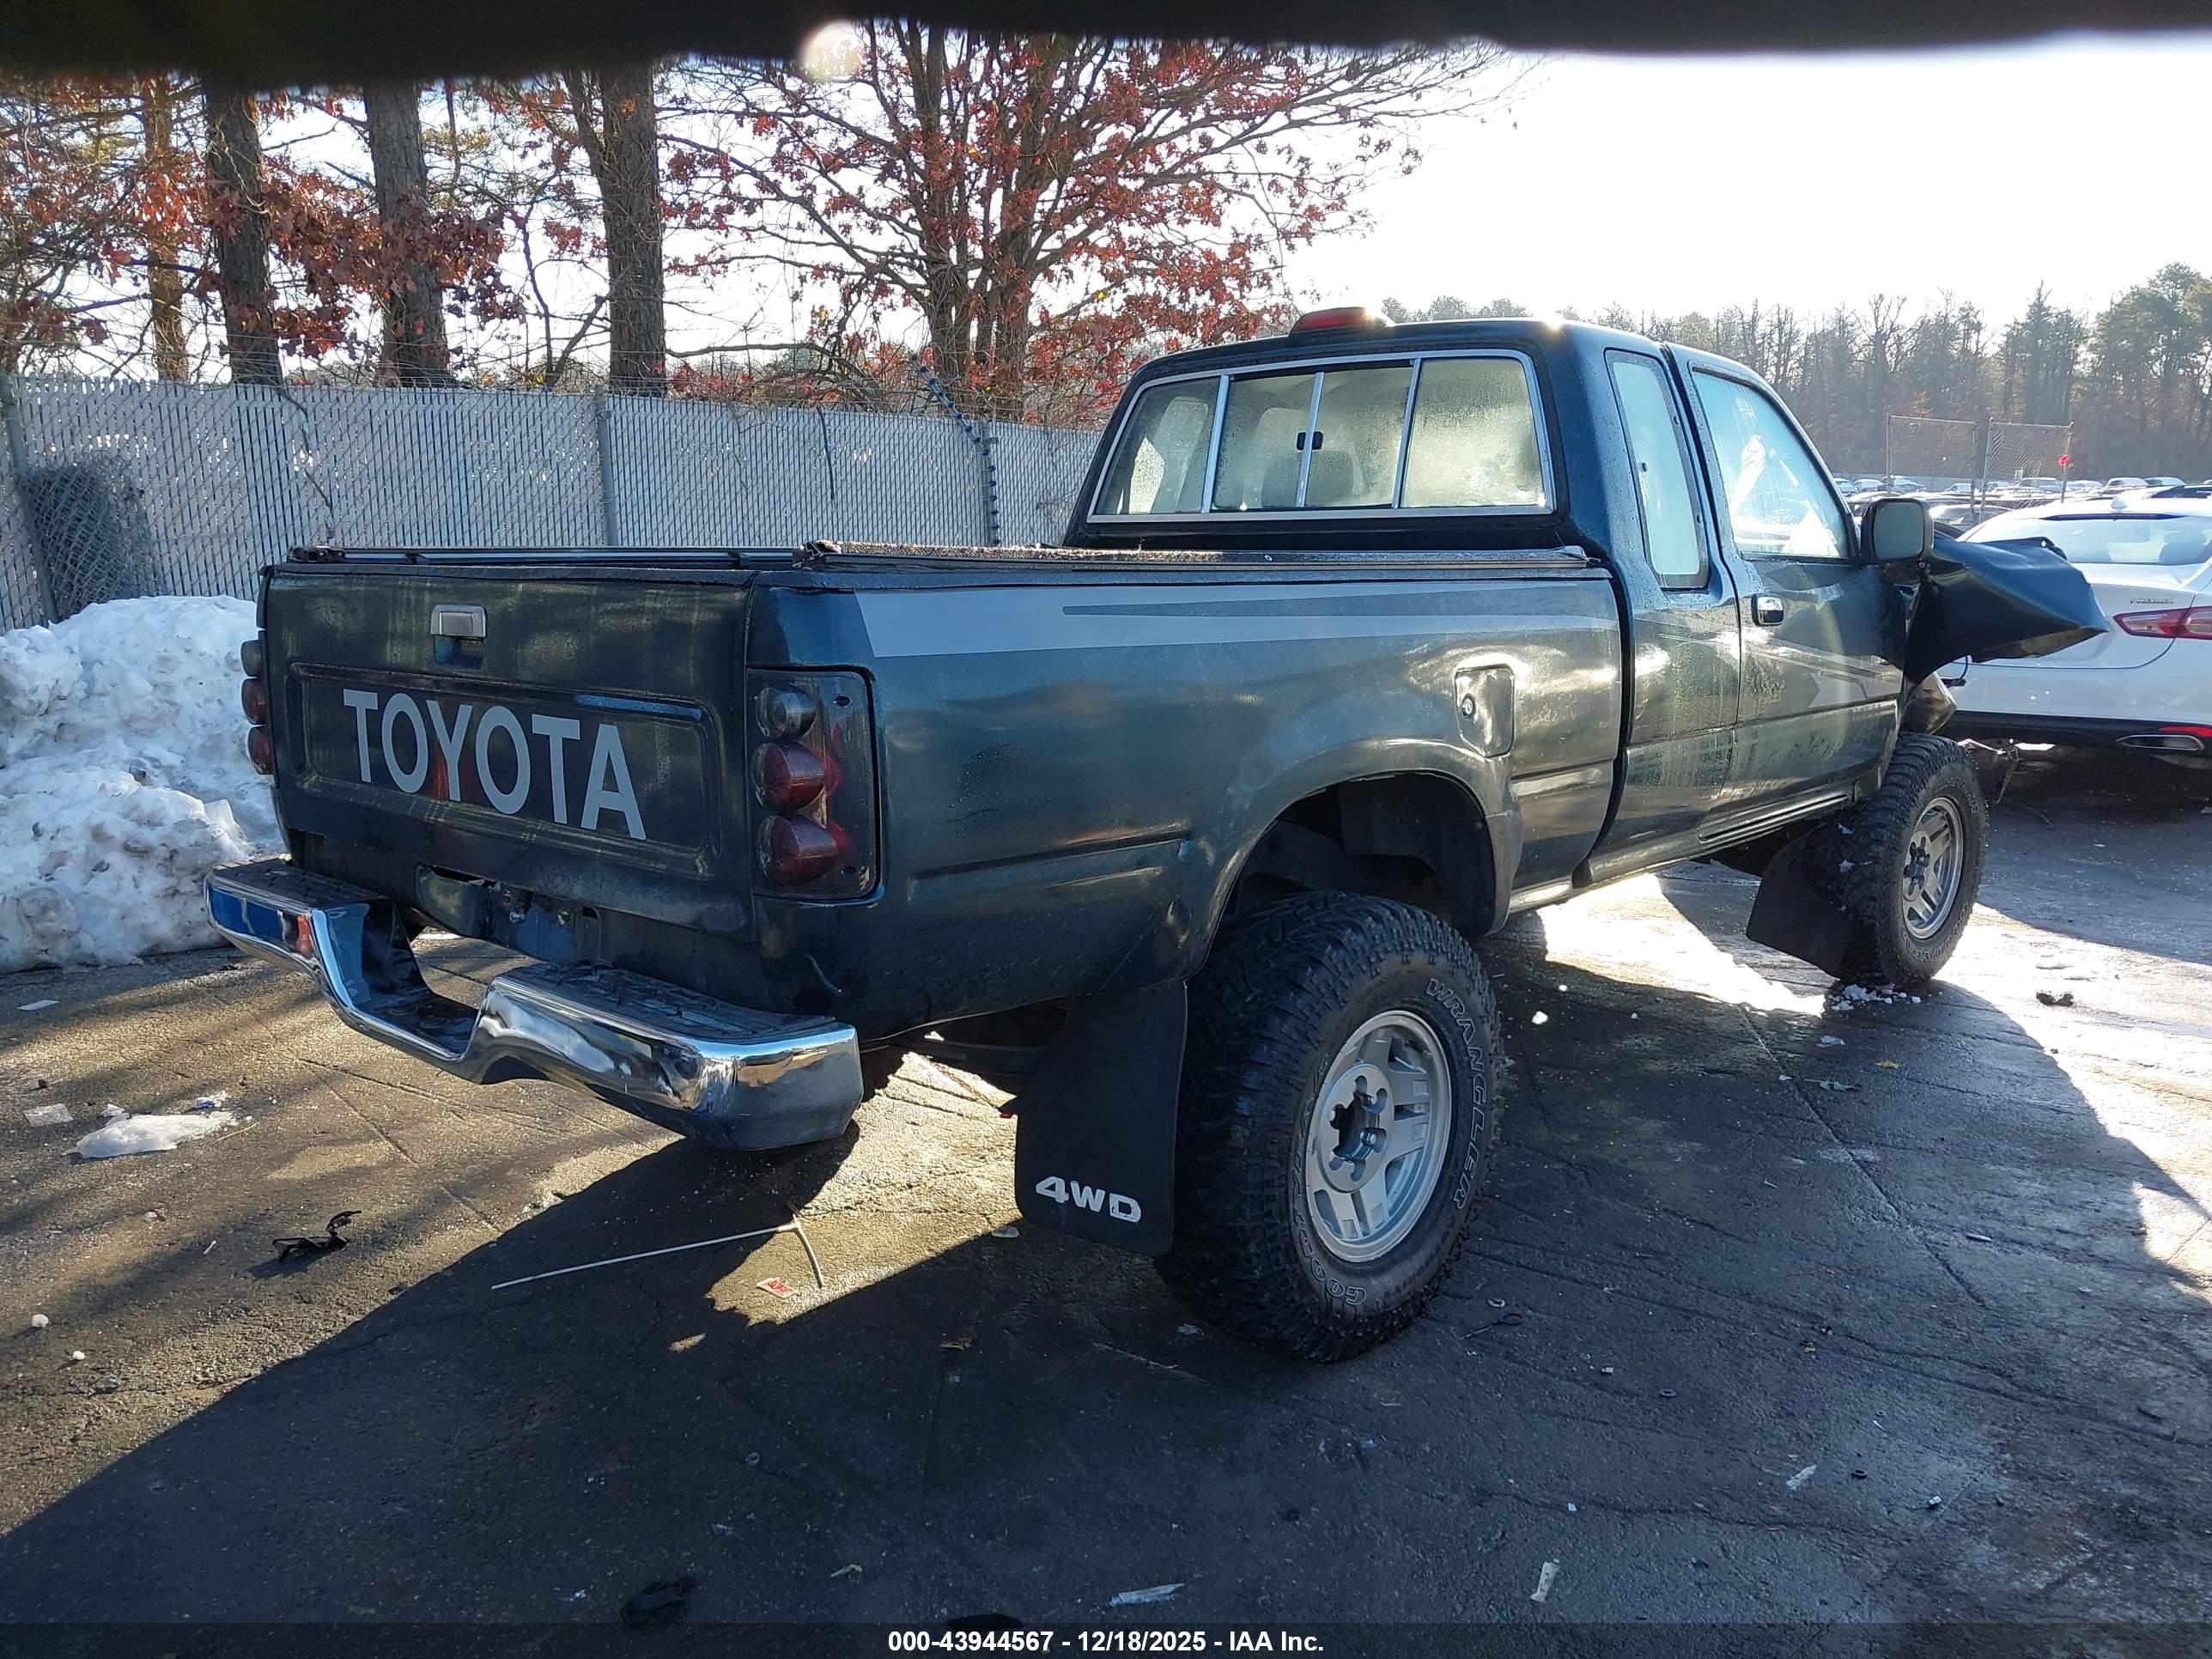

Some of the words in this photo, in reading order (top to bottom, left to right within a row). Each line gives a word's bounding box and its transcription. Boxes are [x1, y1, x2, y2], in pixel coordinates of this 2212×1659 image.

[343, 689, 647, 840] TOYOTA
[1425, 978, 1486, 1209] WRANGLER
[1036, 1176, 1142, 1223] 4WD
